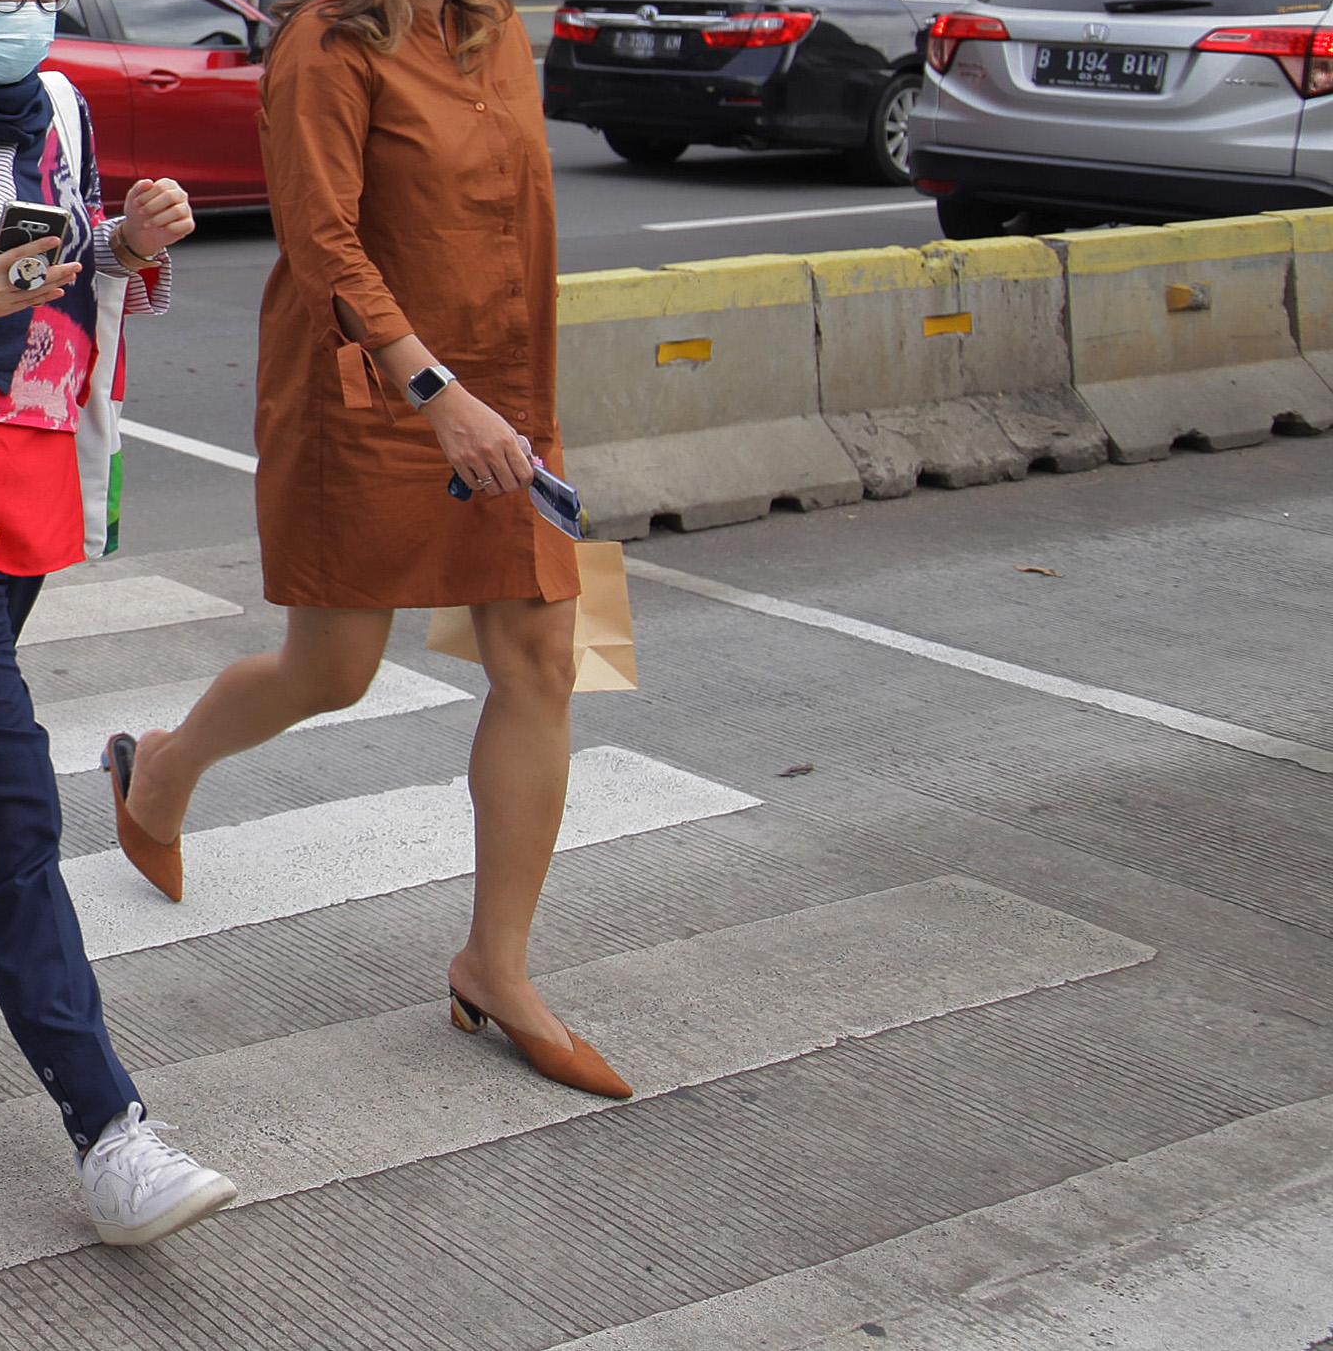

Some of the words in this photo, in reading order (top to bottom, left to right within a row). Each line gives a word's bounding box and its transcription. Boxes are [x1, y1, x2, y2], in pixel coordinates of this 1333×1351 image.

[1038, 48, 1051, 68] B
[1066, 50, 1109, 72] 1194
[1121, 53, 1162, 76] BIW
